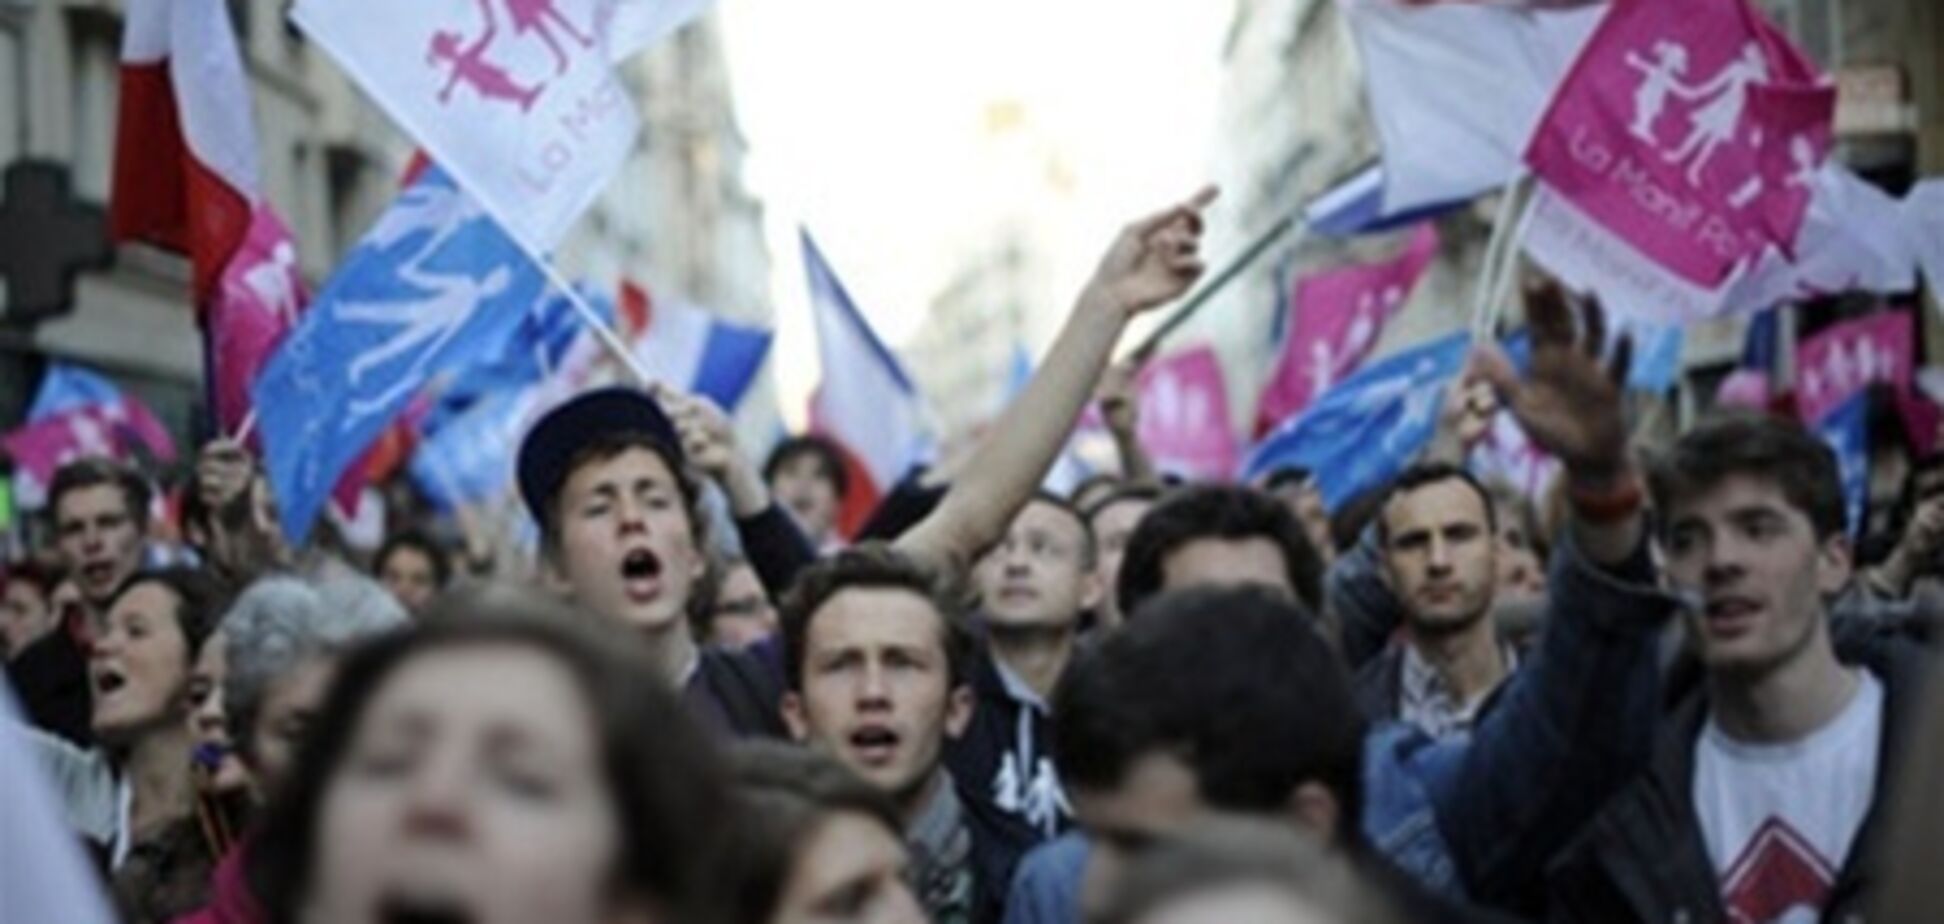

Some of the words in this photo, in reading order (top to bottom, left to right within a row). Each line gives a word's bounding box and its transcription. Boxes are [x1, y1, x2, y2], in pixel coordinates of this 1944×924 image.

[515, 140, 573, 195] La
[1568, 125, 1612, 174] La
[1609, 155, 1704, 229] Manif
